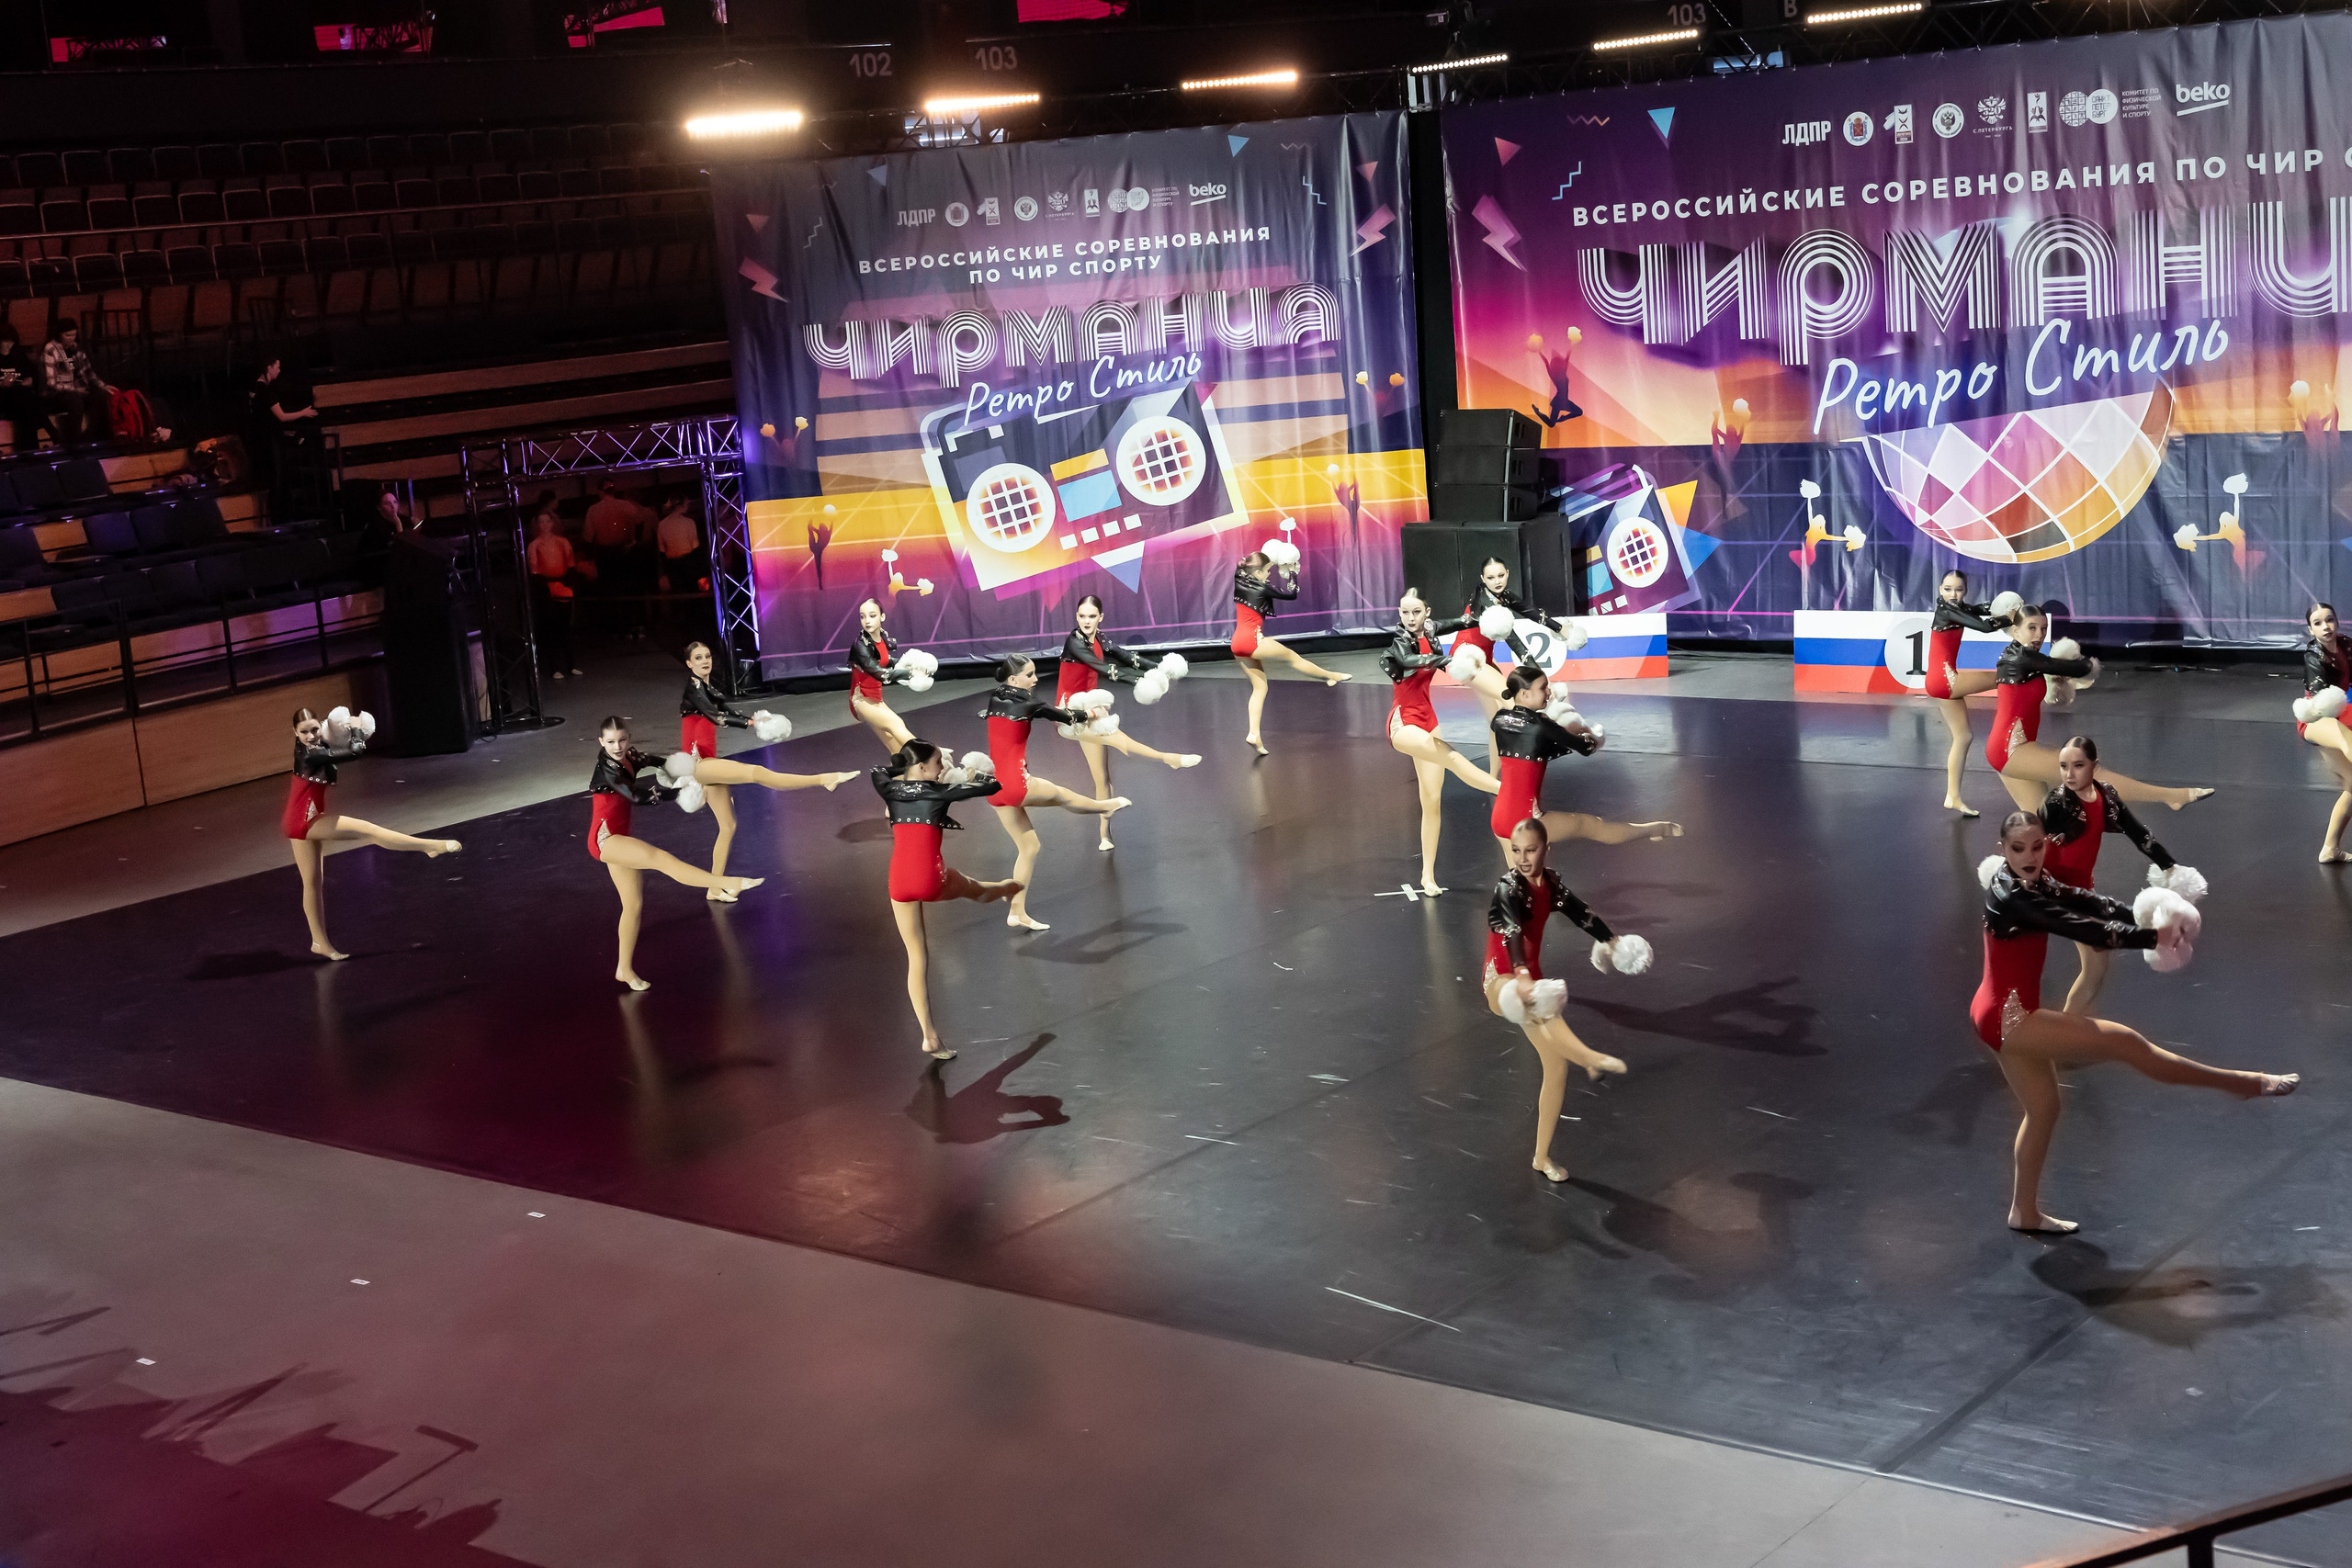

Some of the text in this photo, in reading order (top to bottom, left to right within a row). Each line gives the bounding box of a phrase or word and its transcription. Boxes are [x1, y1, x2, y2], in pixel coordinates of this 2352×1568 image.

[1668, 3, 1706, 26] 103
[849, 51, 892, 78] 102
[975, 46, 1018, 71] 103
[2121, 88, 2150, 96] КОМИТЕТ
[2121, 94, 2162, 104] ФИЗИЧЕСКОЙ
[2176, 81, 2231, 104] beko
[2122, 103, 2150, 111] КУЛЬТУРЕ
[1781, 120, 1832, 146] ЛДПР
[1188, 182, 1227, 197] beko
[1572, 186, 1846, 227] ВСЕРОССИЙСКИЕ
[1861, 161, 2155, 204] СОРЕВНОВАНИЯ
[2176, 156, 2226, 181] ПО
[2246, 149, 2324, 175] ЧИР
[897, 209, 936, 227] ЛДПР
[858, 226, 1272, 275] ВСЕРОССИЙСКИЕ СОРЕВНОВАНИЯ
[968, 254, 1162, 285] ПО ЧИР СПОРТУ
[962, 352, 1203, 426] Ретро Стиль
[1813, 318, 2230, 435] Ретро Стиль
[1525, 632, 1553, 669] 2
[1905, 630, 1928, 676] 1
